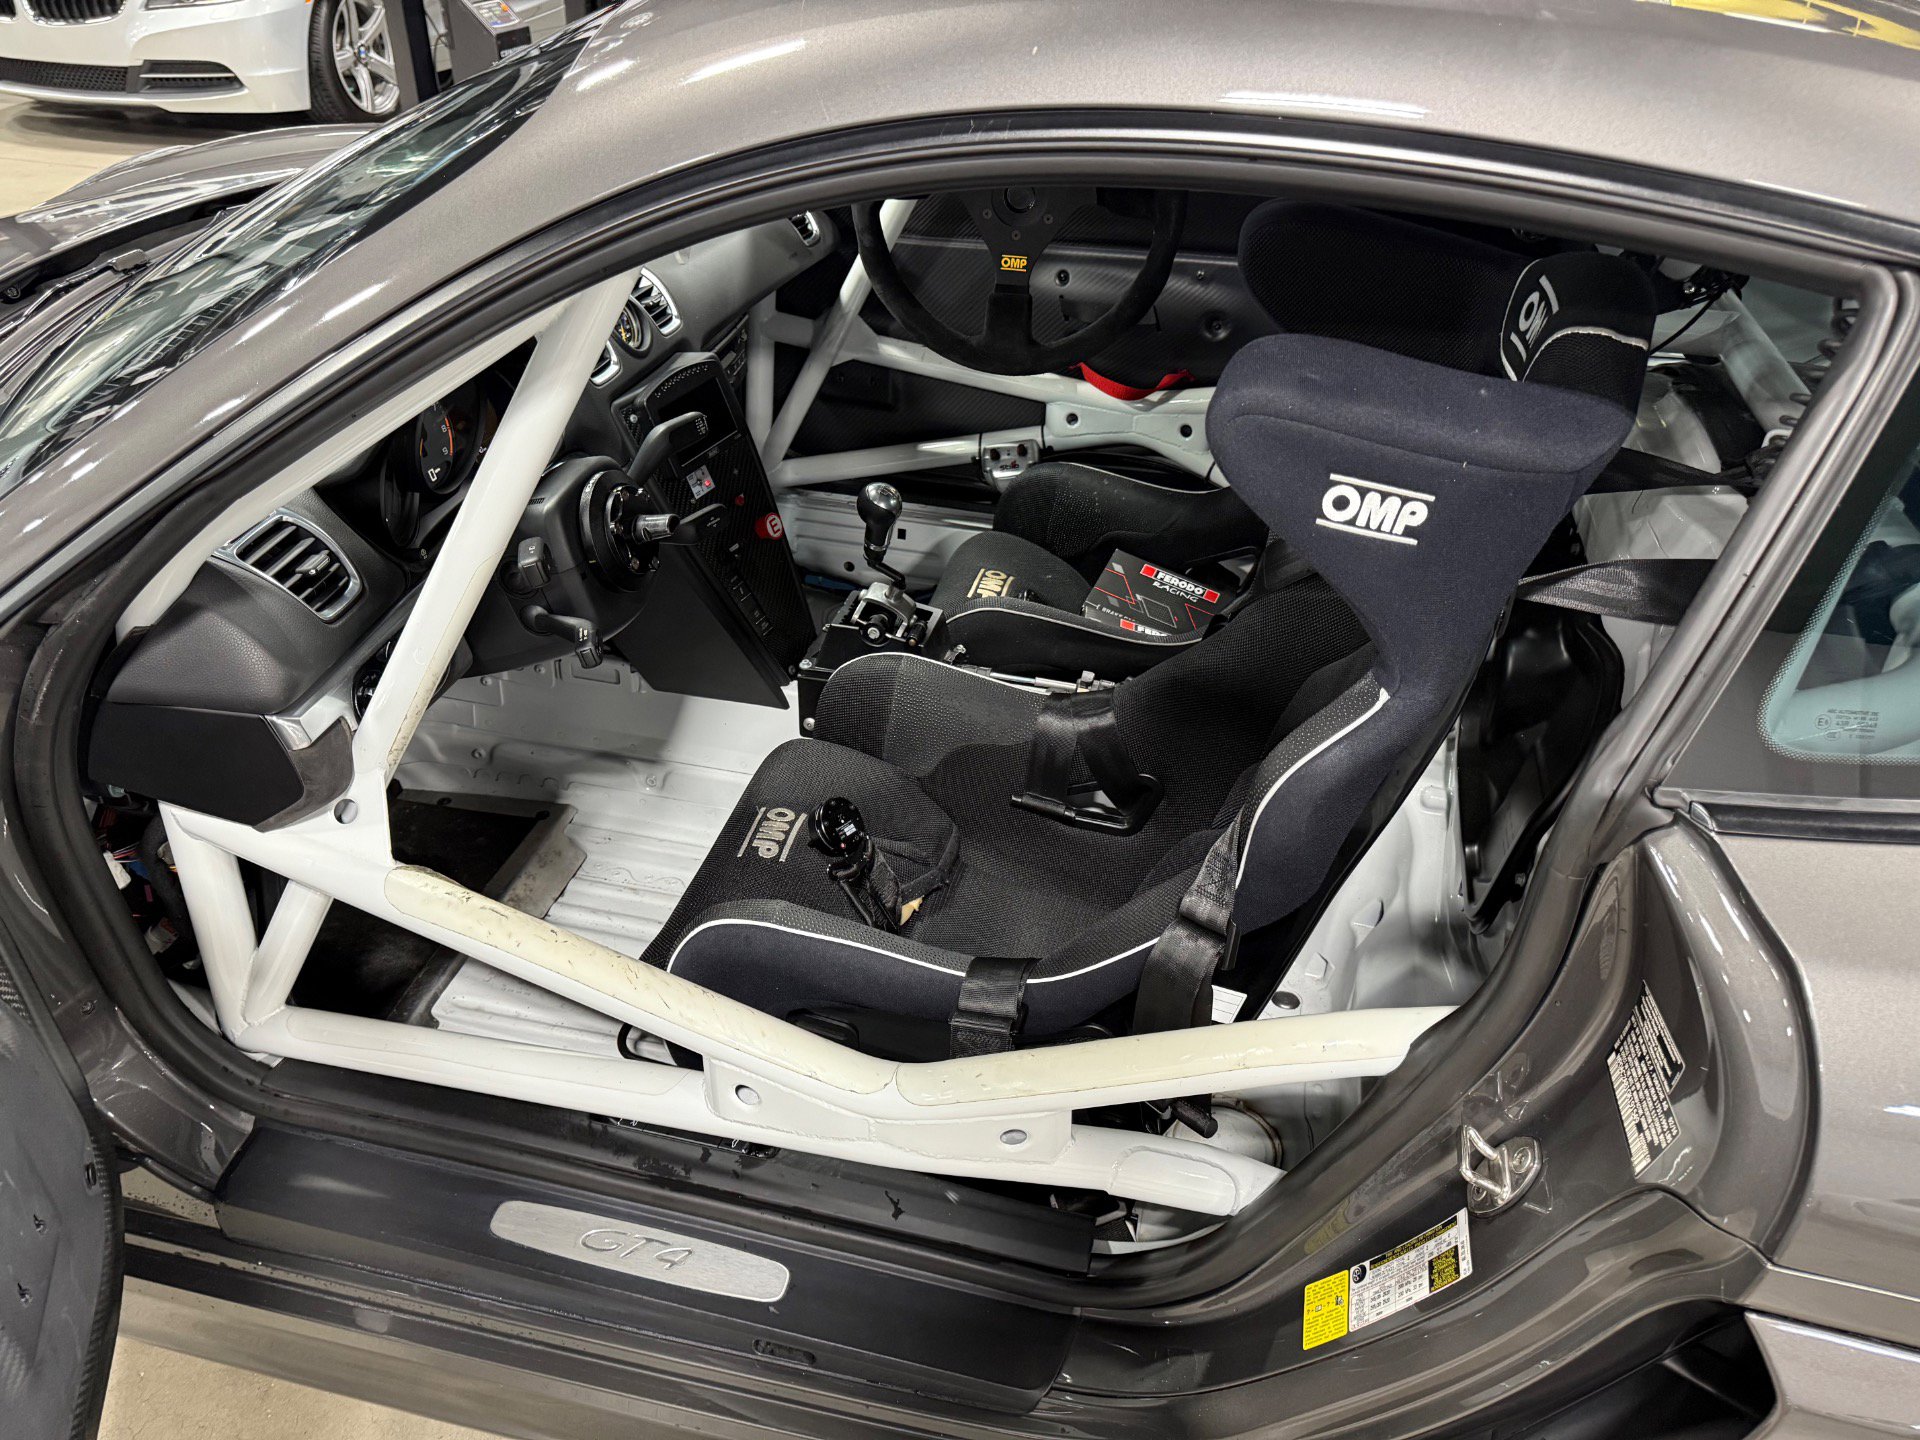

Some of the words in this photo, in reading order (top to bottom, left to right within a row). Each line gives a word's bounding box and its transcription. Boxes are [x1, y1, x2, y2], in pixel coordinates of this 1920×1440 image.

[1001, 257, 1027, 269] OMP
[1321, 484, 1429, 536] OMP
[768, 517, 782, 535] E
[1152, 581, 1200, 603] RACING
[1155, 570, 1205, 596] FERODO
[752, 807, 796, 859] OMP
[580, 1229, 693, 1270] GT4
